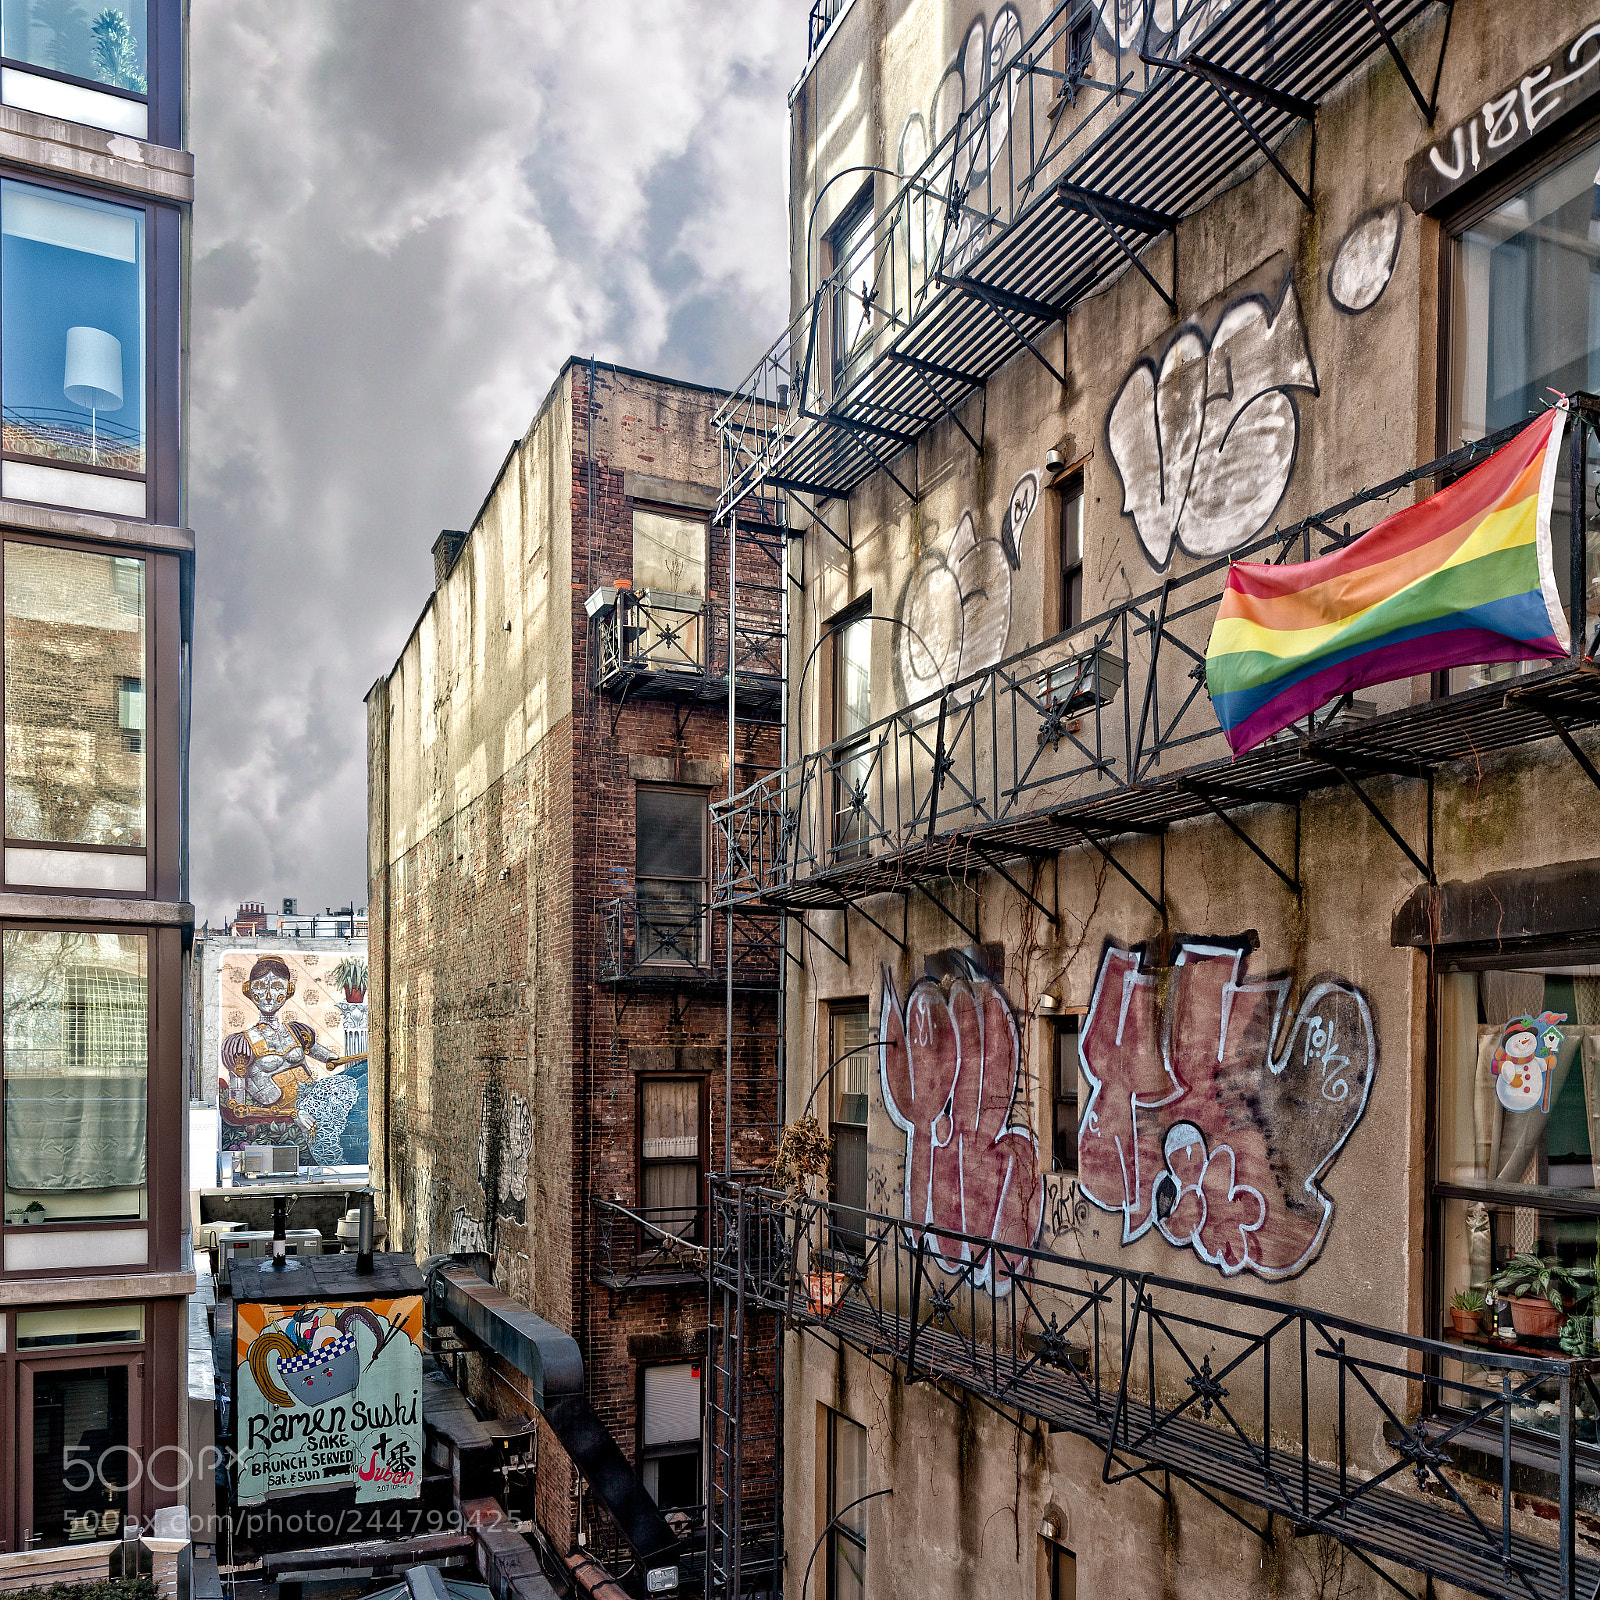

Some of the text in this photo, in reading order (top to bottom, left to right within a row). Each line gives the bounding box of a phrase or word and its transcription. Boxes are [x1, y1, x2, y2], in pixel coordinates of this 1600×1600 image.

[248, 1389, 419, 1450] Ramen Sushi
[307, 1434, 350, 1451] SAKE
[251, 1450, 354, 1476] BRUNCH SERVED
[359, 1451, 414, 1484] Juban
